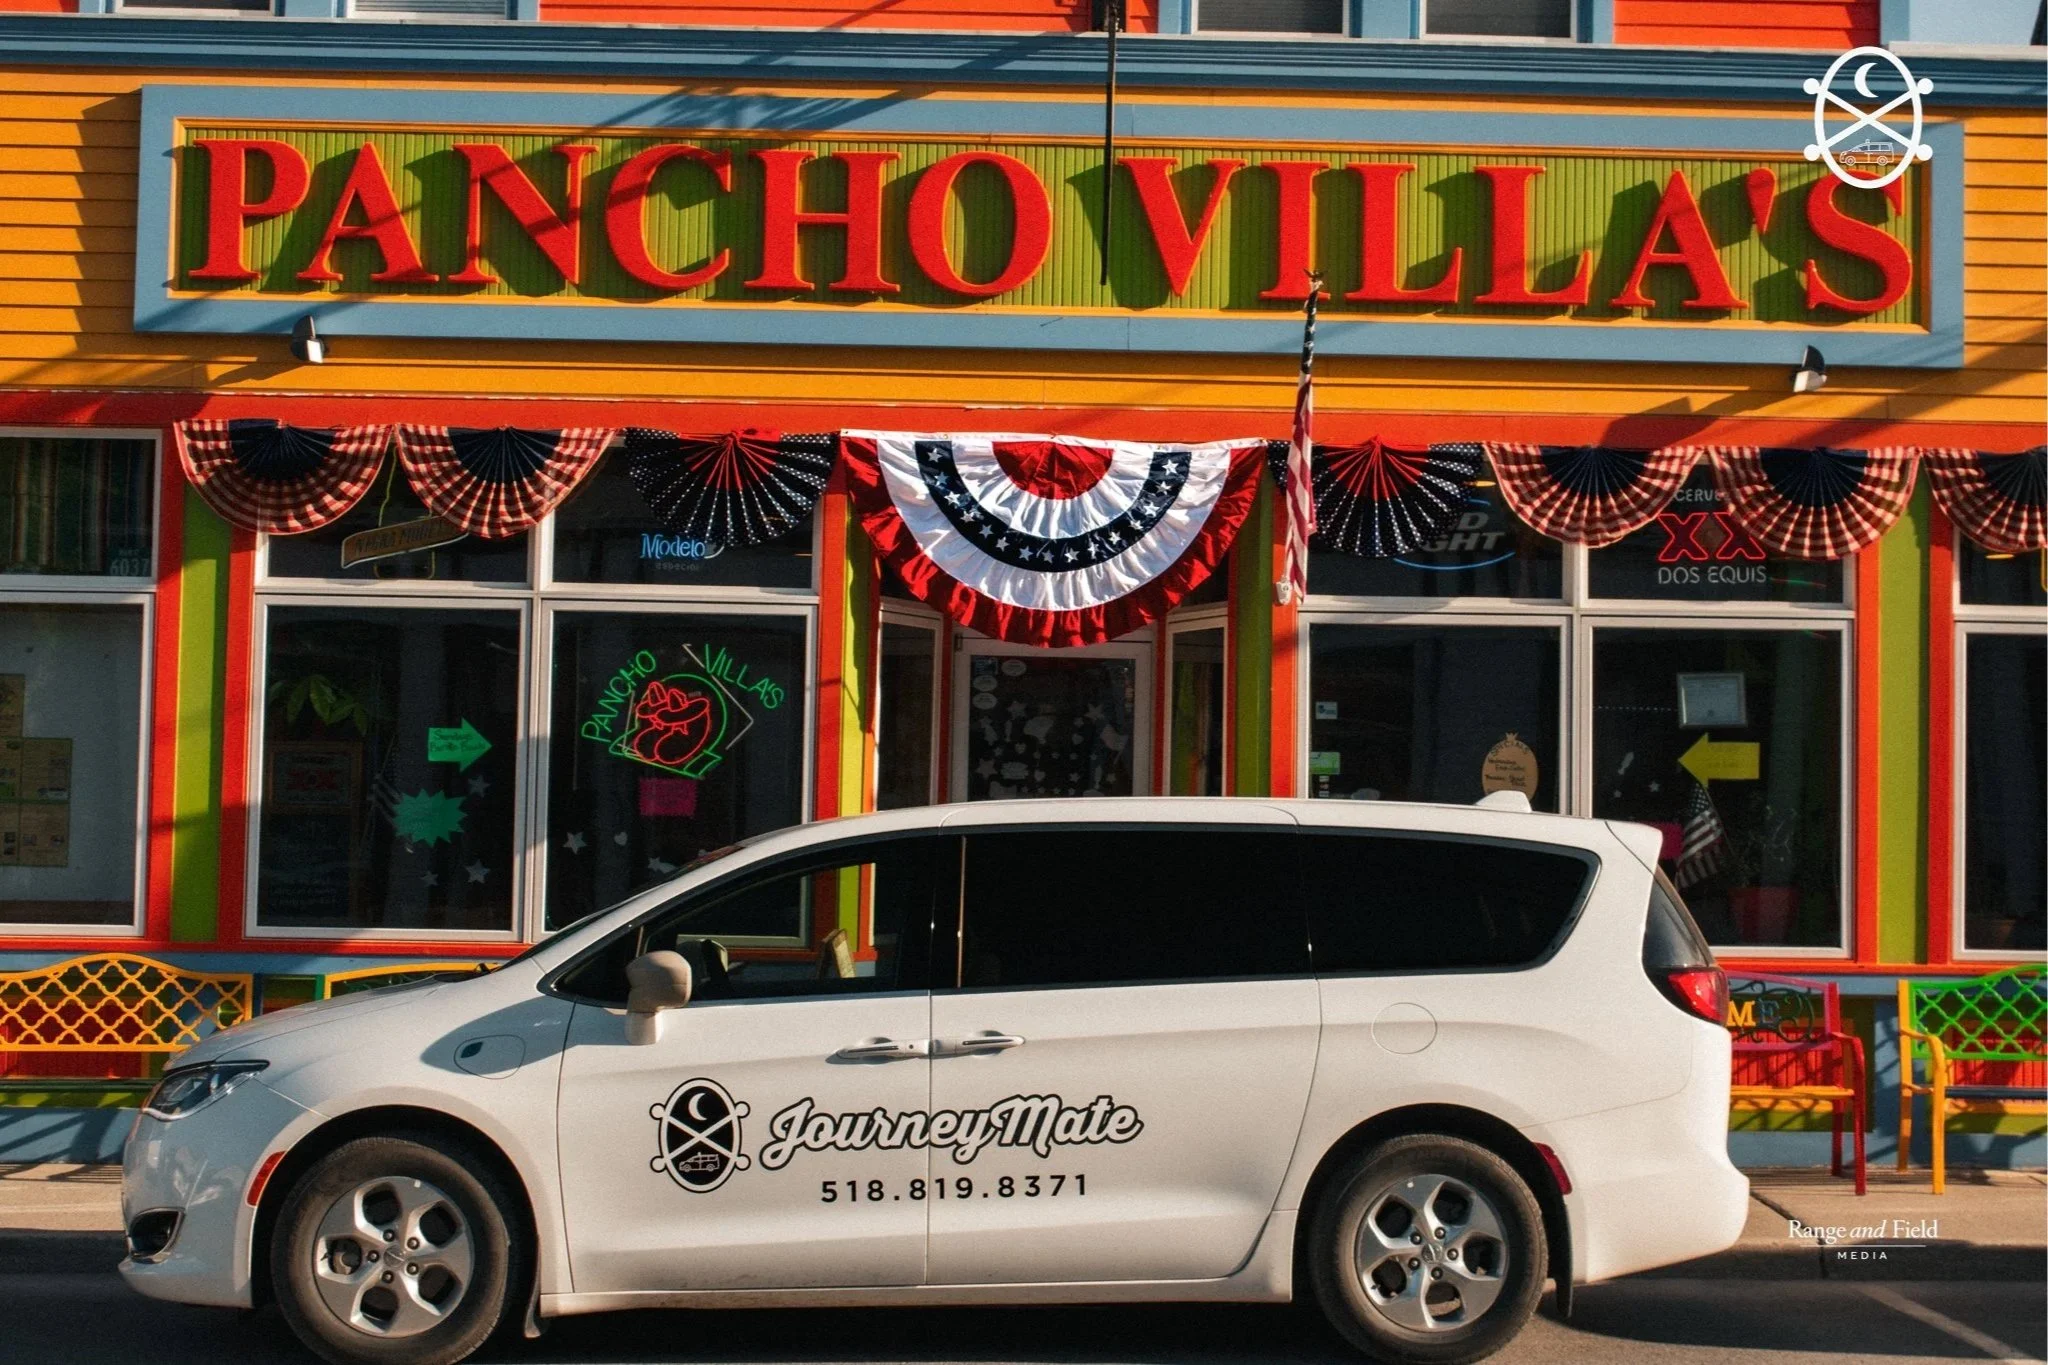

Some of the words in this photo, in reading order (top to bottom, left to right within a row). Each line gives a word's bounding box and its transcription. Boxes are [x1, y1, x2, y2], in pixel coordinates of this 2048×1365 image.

[188, 137, 1052, 297] PANCHO
[1118, 155, 1914, 314] VILLA'S
[639, 532, 706, 560] Modelo
[1657, 511, 1767, 563] XX
[1657, 566, 1701, 585] DOS
[1706, 565, 1768, 585] EQUIS
[580, 649, 657, 743] PANCHO
[703, 643, 786, 710] VILLA'S
[759, 1093, 1145, 1171] JourneyMate
[820, 1173, 1088, 1204] 518.819.8371
